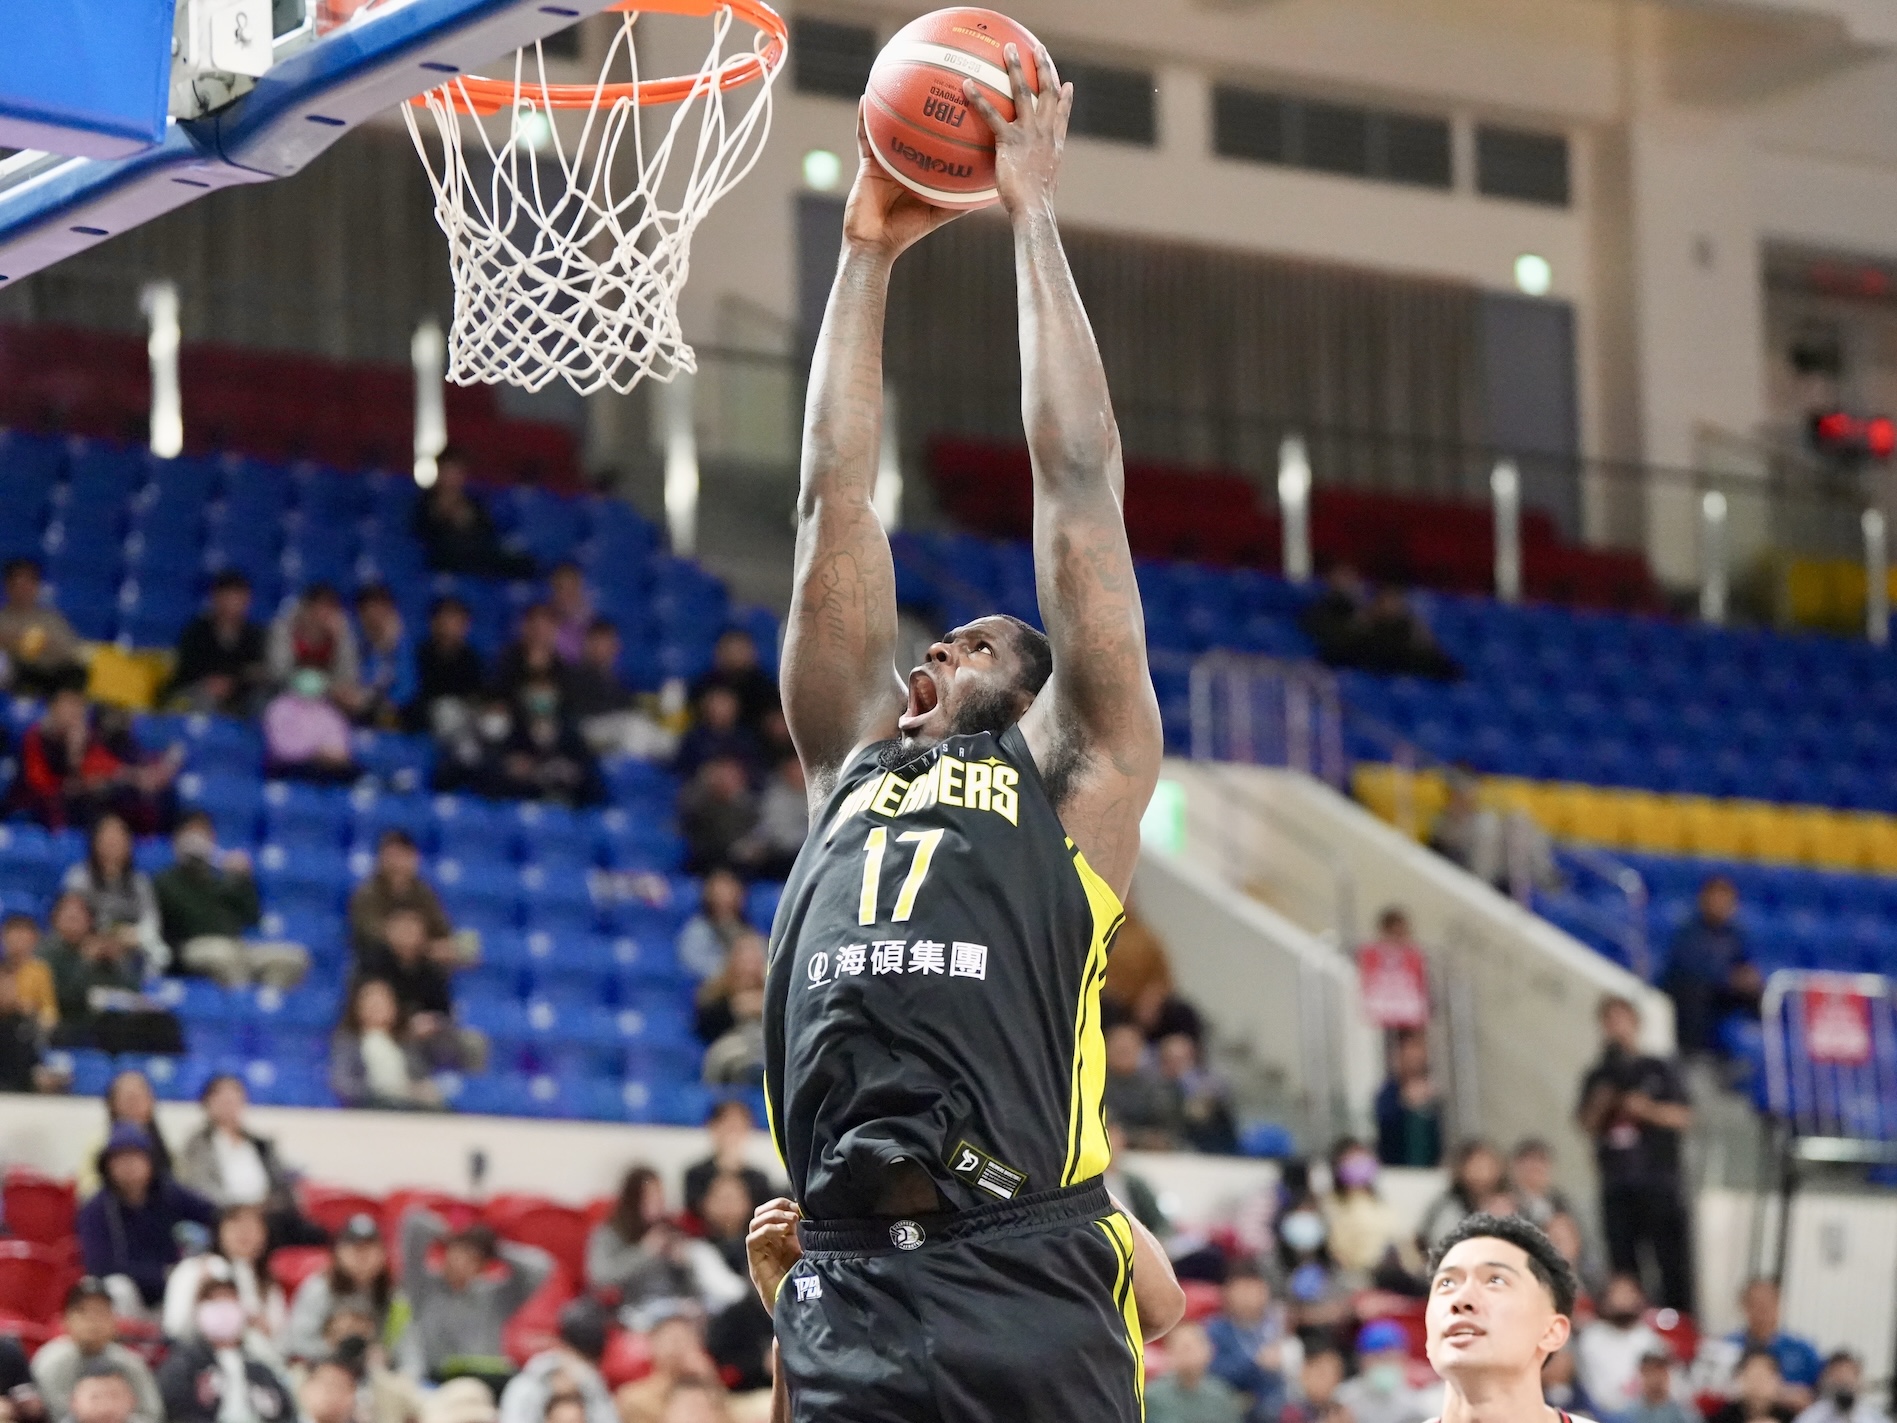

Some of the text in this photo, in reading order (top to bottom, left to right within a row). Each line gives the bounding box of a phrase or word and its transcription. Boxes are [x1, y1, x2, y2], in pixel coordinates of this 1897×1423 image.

[952, 27, 1000, 48] COMPETITION
[944, 53, 982, 73] BG4500
[923, 96, 967, 128] FIBA
[930, 86, 969, 106] APPROVED
[891, 137, 973, 178] molten
[859, 826, 945, 926] 17
[834, 940, 988, 981] 海碩集團
